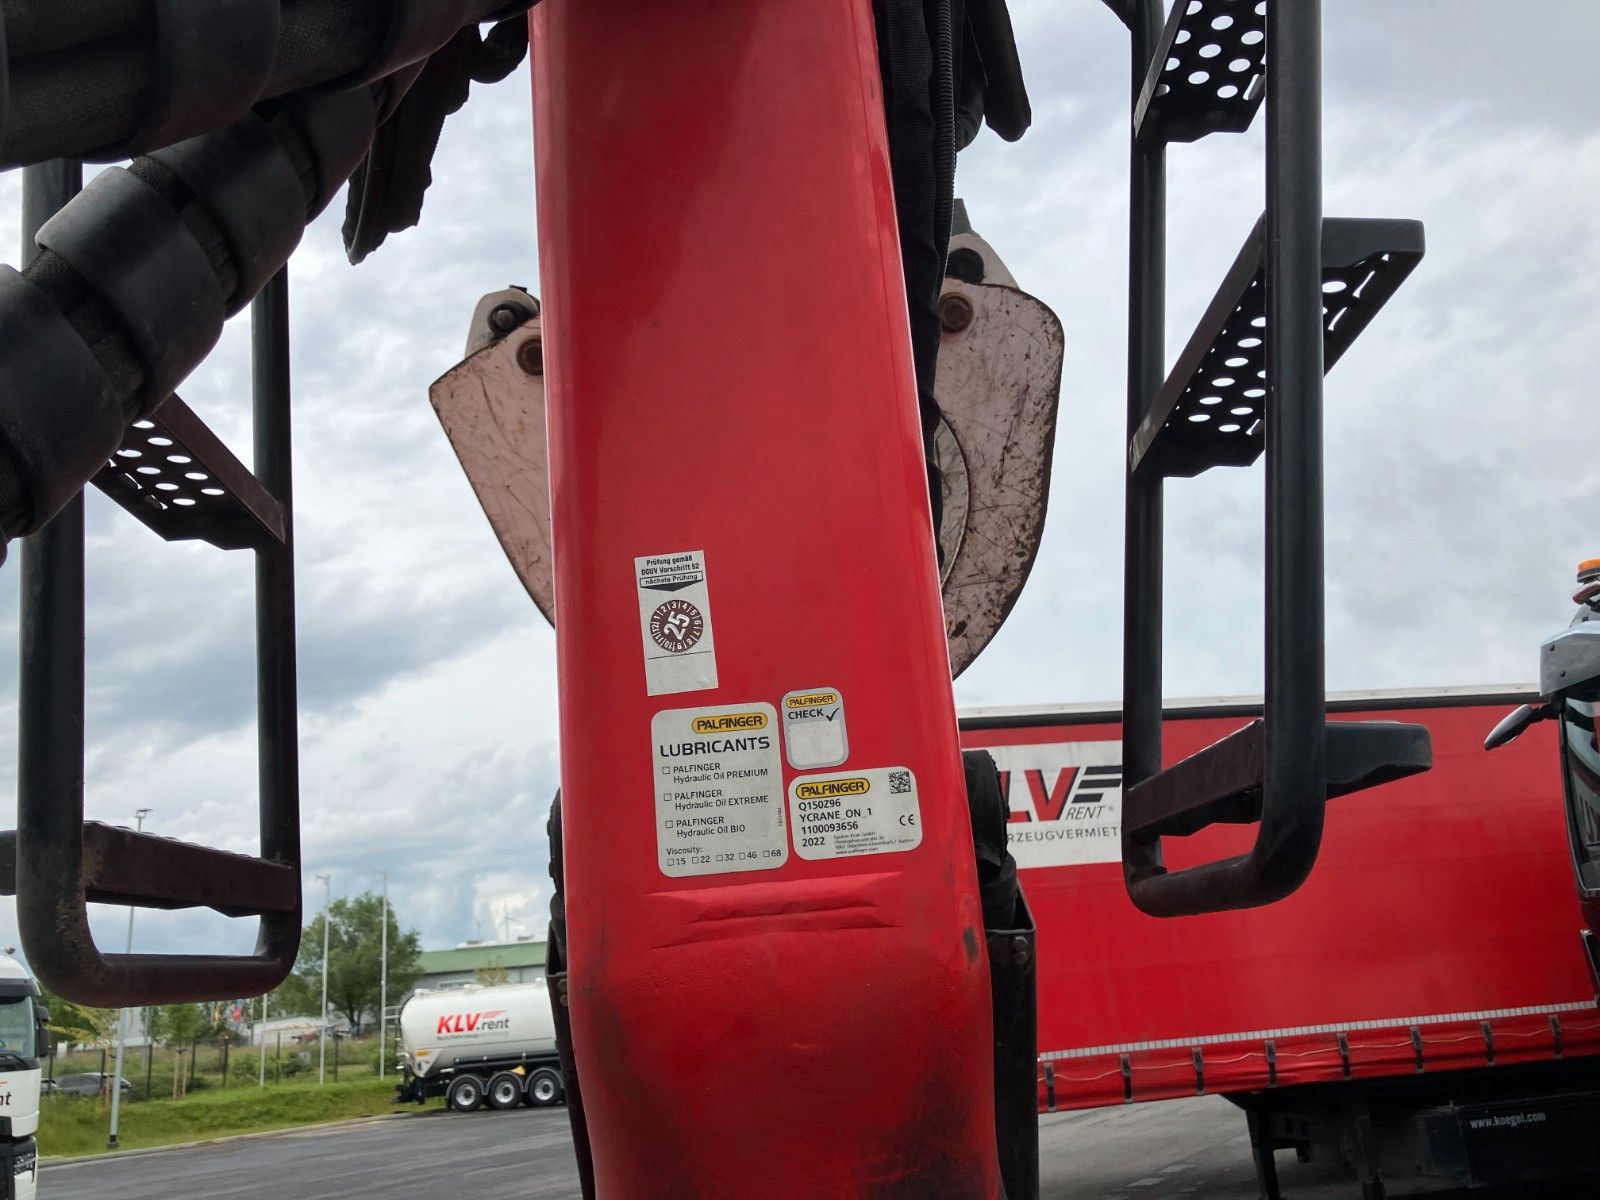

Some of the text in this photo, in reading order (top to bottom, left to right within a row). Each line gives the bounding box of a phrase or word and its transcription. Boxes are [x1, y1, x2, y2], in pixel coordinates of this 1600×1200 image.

[646, 559, 671, 567] Prüfung
[660, 564, 691, 573] Vorschrift
[645, 574, 698, 585] nächste Prüfung
[664, 611, 690, 640] 25
[789, 695, 834, 706] PALFINGER
[787, 708, 824, 720] CHECK
[697, 715, 763, 731] PALFINGER
[660, 736, 770, 757] LUBRICANTS
[673, 763, 721, 774] PALFINGER
[673, 768, 768, 785] Hydraulic Oil PREMIUM
[674, 790, 723, 800] PALFINGER
[801, 781, 865, 797] PALFINGER
[997, 767, 1080, 823] LV
[675, 795, 769, 812] Hydraulic Oil EXTREME
[798, 799, 841, 811] Q150Z96
[676, 817, 725, 828] PALFINGER
[801, 821, 859, 835] 1100093656
[676, 825, 746, 839] Hydraulic Oil BIO
[1007, 827, 1118, 843] RZEUGVERMIET
[802, 837, 826, 847] 2022
[666, 846, 703, 856] Viscosity:
[676, 849, 782, 866] 15 22 32 46 68
[1469, 1112, 1547, 1129] www.koegel.com
